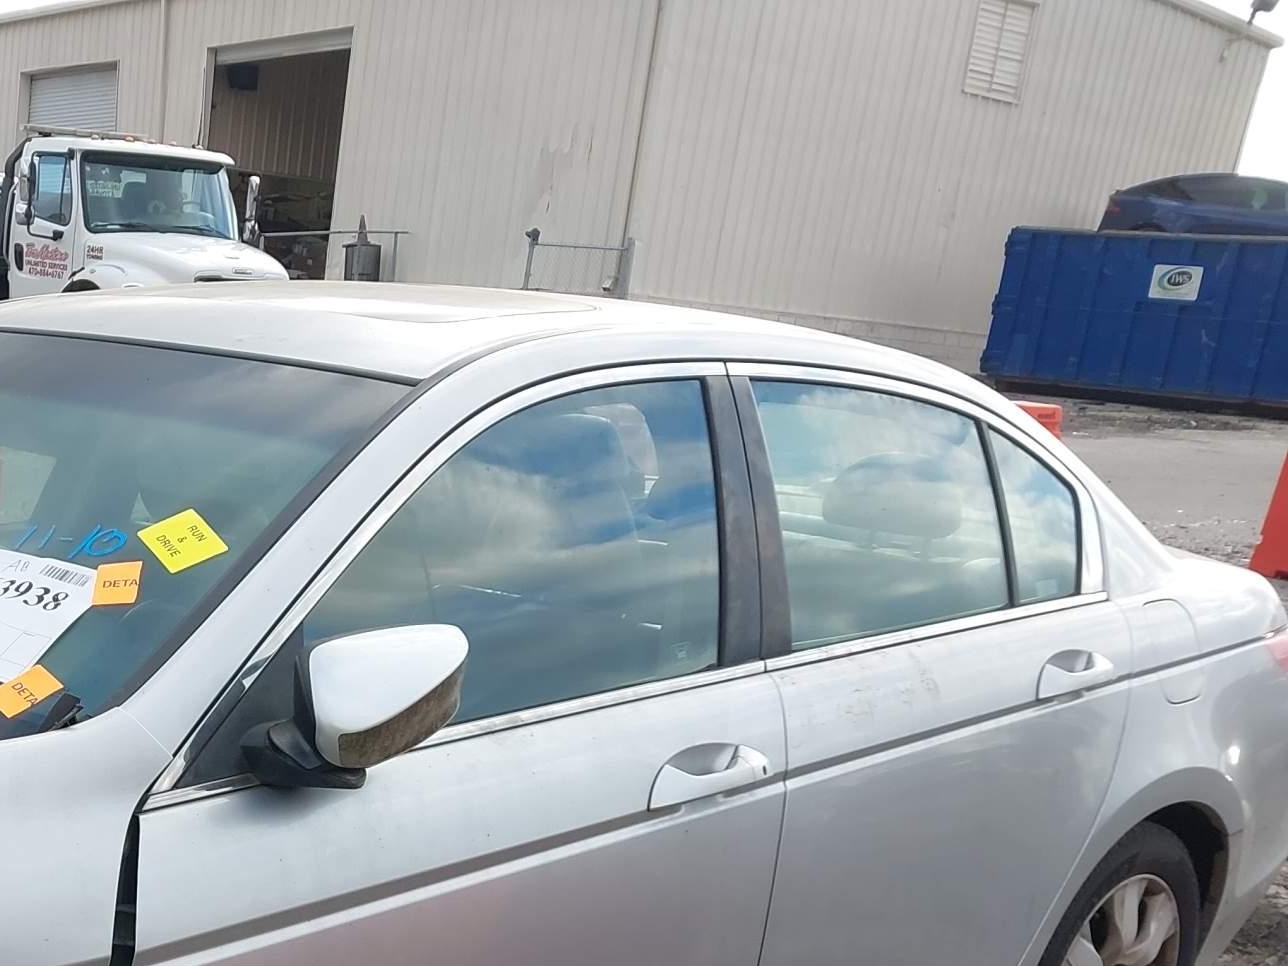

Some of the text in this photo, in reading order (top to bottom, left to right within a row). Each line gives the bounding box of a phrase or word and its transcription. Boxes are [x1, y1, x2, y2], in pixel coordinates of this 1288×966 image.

[187, 525, 208, 542] RUN
[156, 534, 181, 557] DRIVE
[102, 579, 138, 588] DETA
